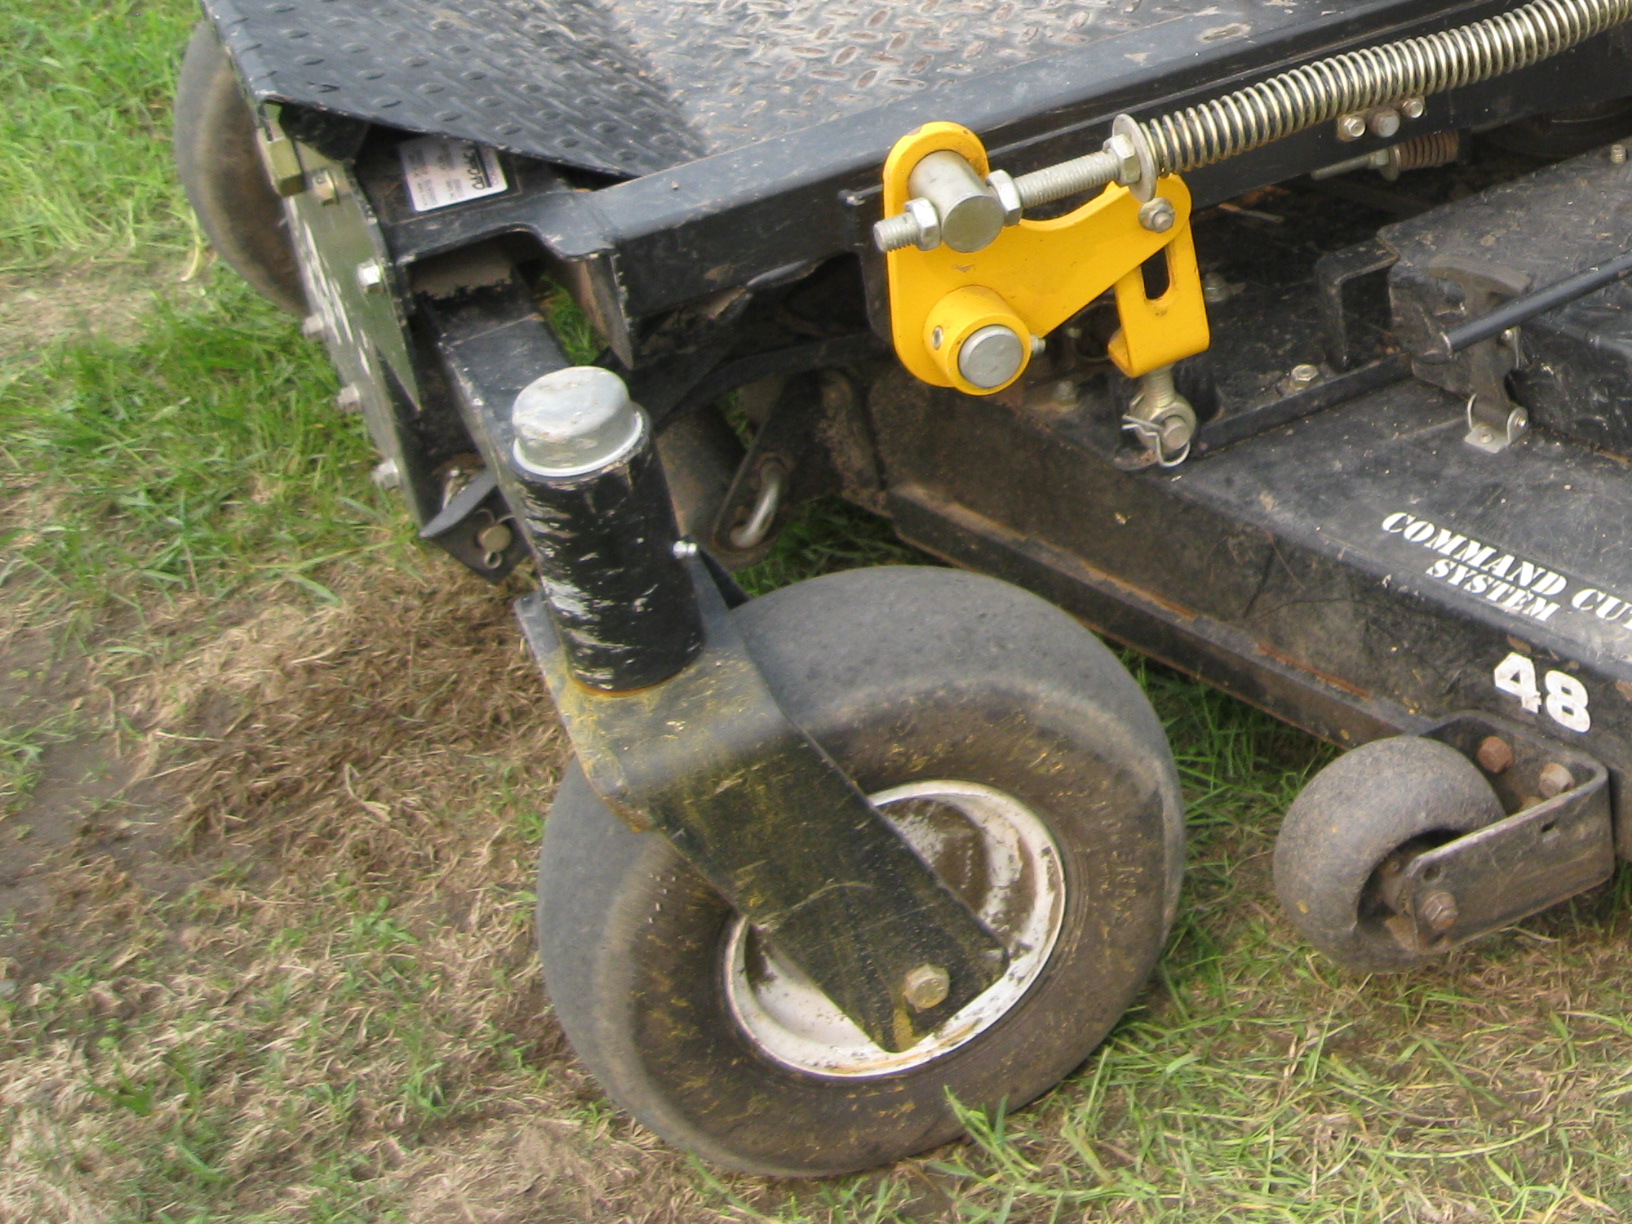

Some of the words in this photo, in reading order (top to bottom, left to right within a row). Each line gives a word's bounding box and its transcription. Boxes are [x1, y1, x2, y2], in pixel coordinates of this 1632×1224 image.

[1381, 511, 1568, 598] COMMAND
[1425, 556, 1561, 623] SYSTEM
[1493, 650, 1591, 734] 48
